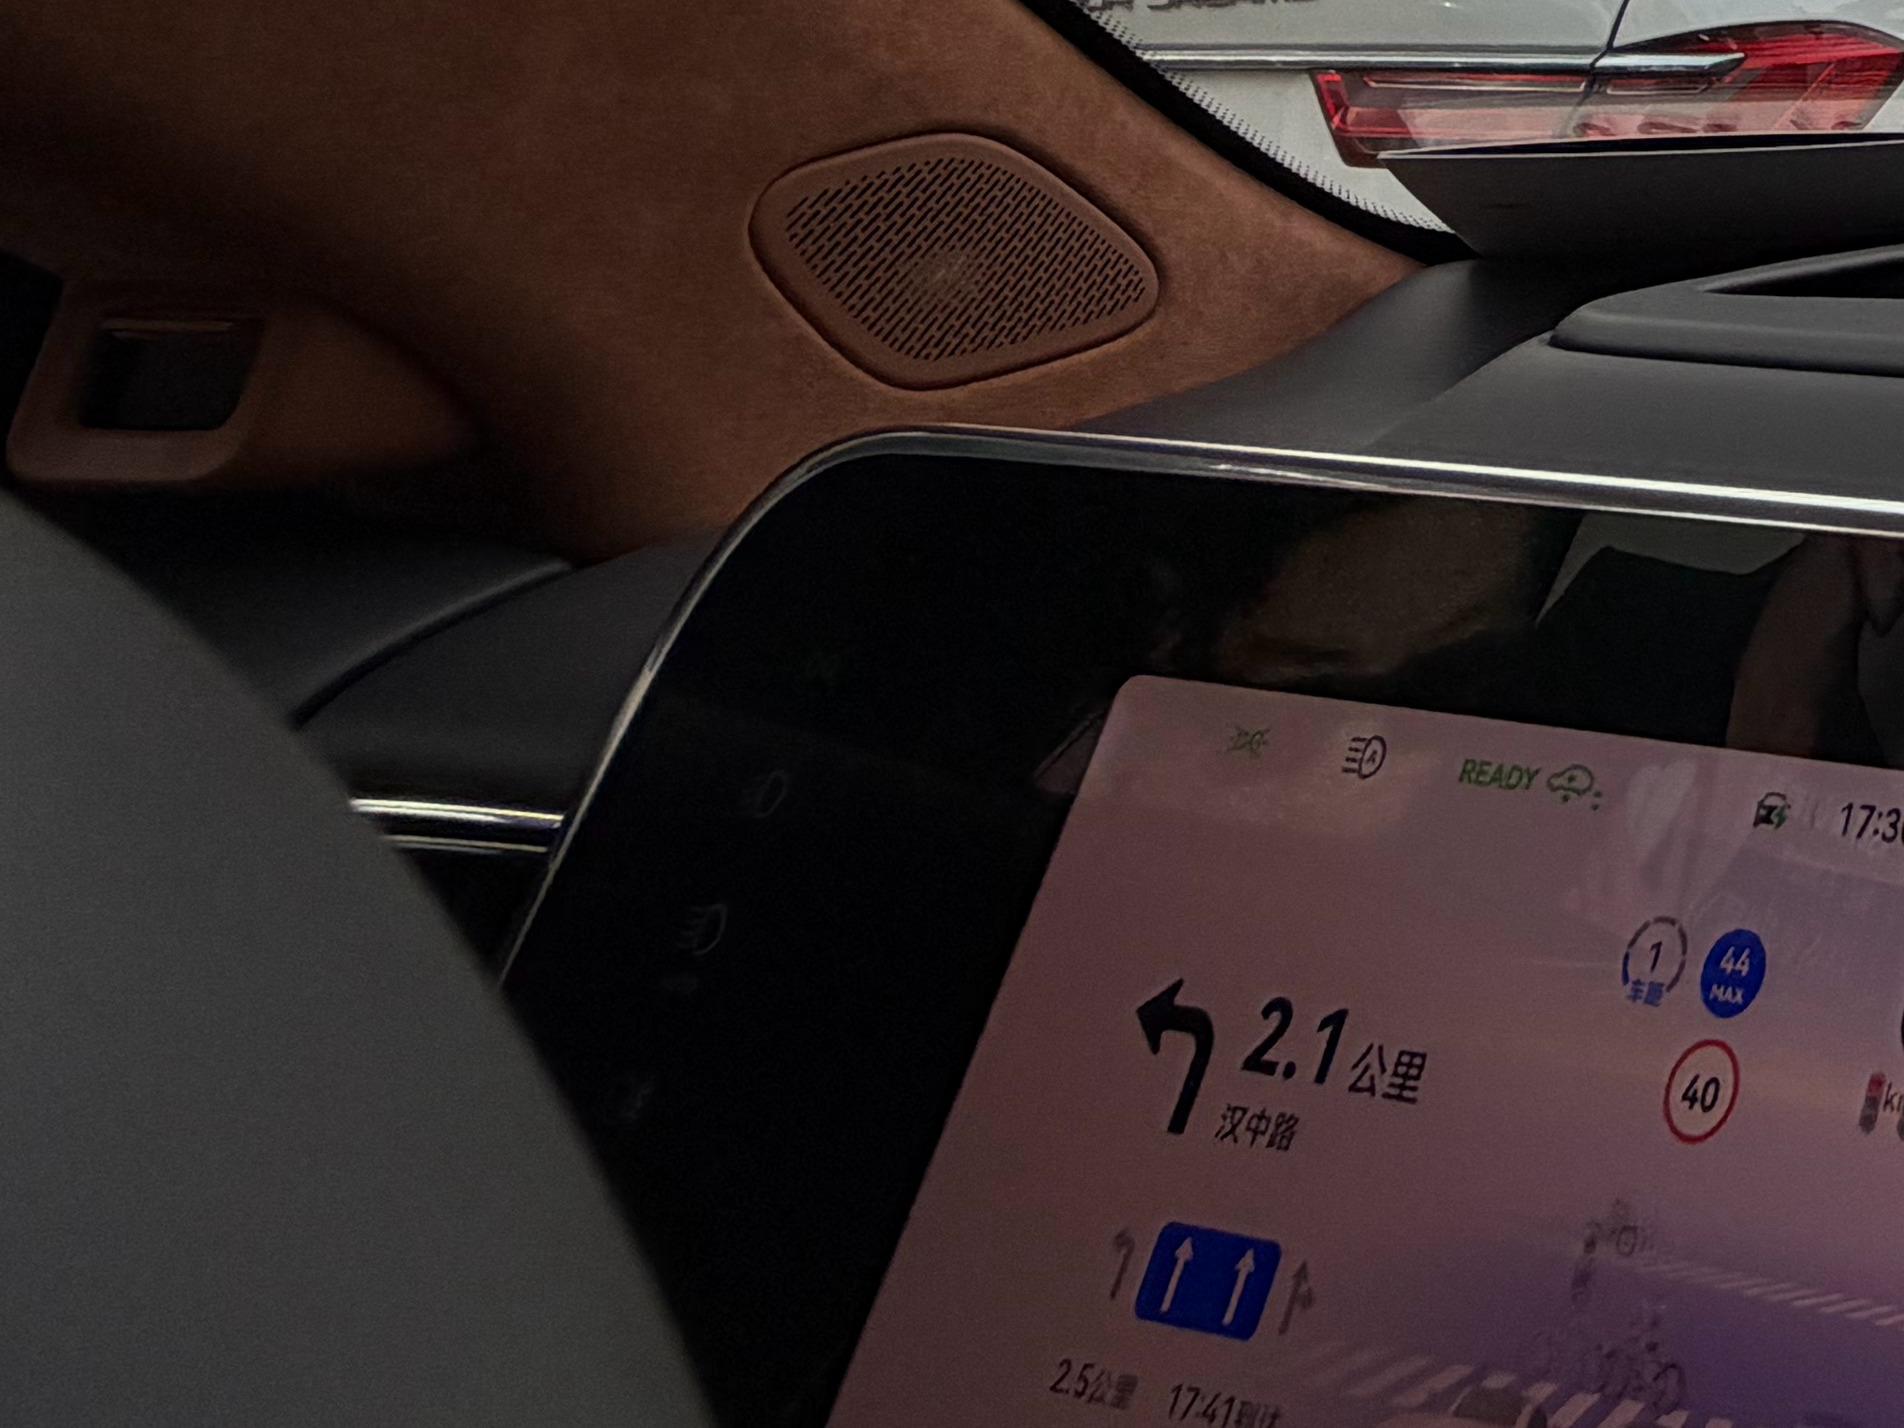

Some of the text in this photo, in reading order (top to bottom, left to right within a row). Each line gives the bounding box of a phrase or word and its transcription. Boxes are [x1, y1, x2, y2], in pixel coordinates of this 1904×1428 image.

[1458, 758, 1541, 791] READY
[1720, 946, 1751, 978] 44
[1709, 984, 1744, 1005] MAX
[1241, 996, 1428, 1105] 2.1 公里
[1681, 1073, 1721, 1113] 40
[1214, 1103, 1300, 1152] 汉中路
